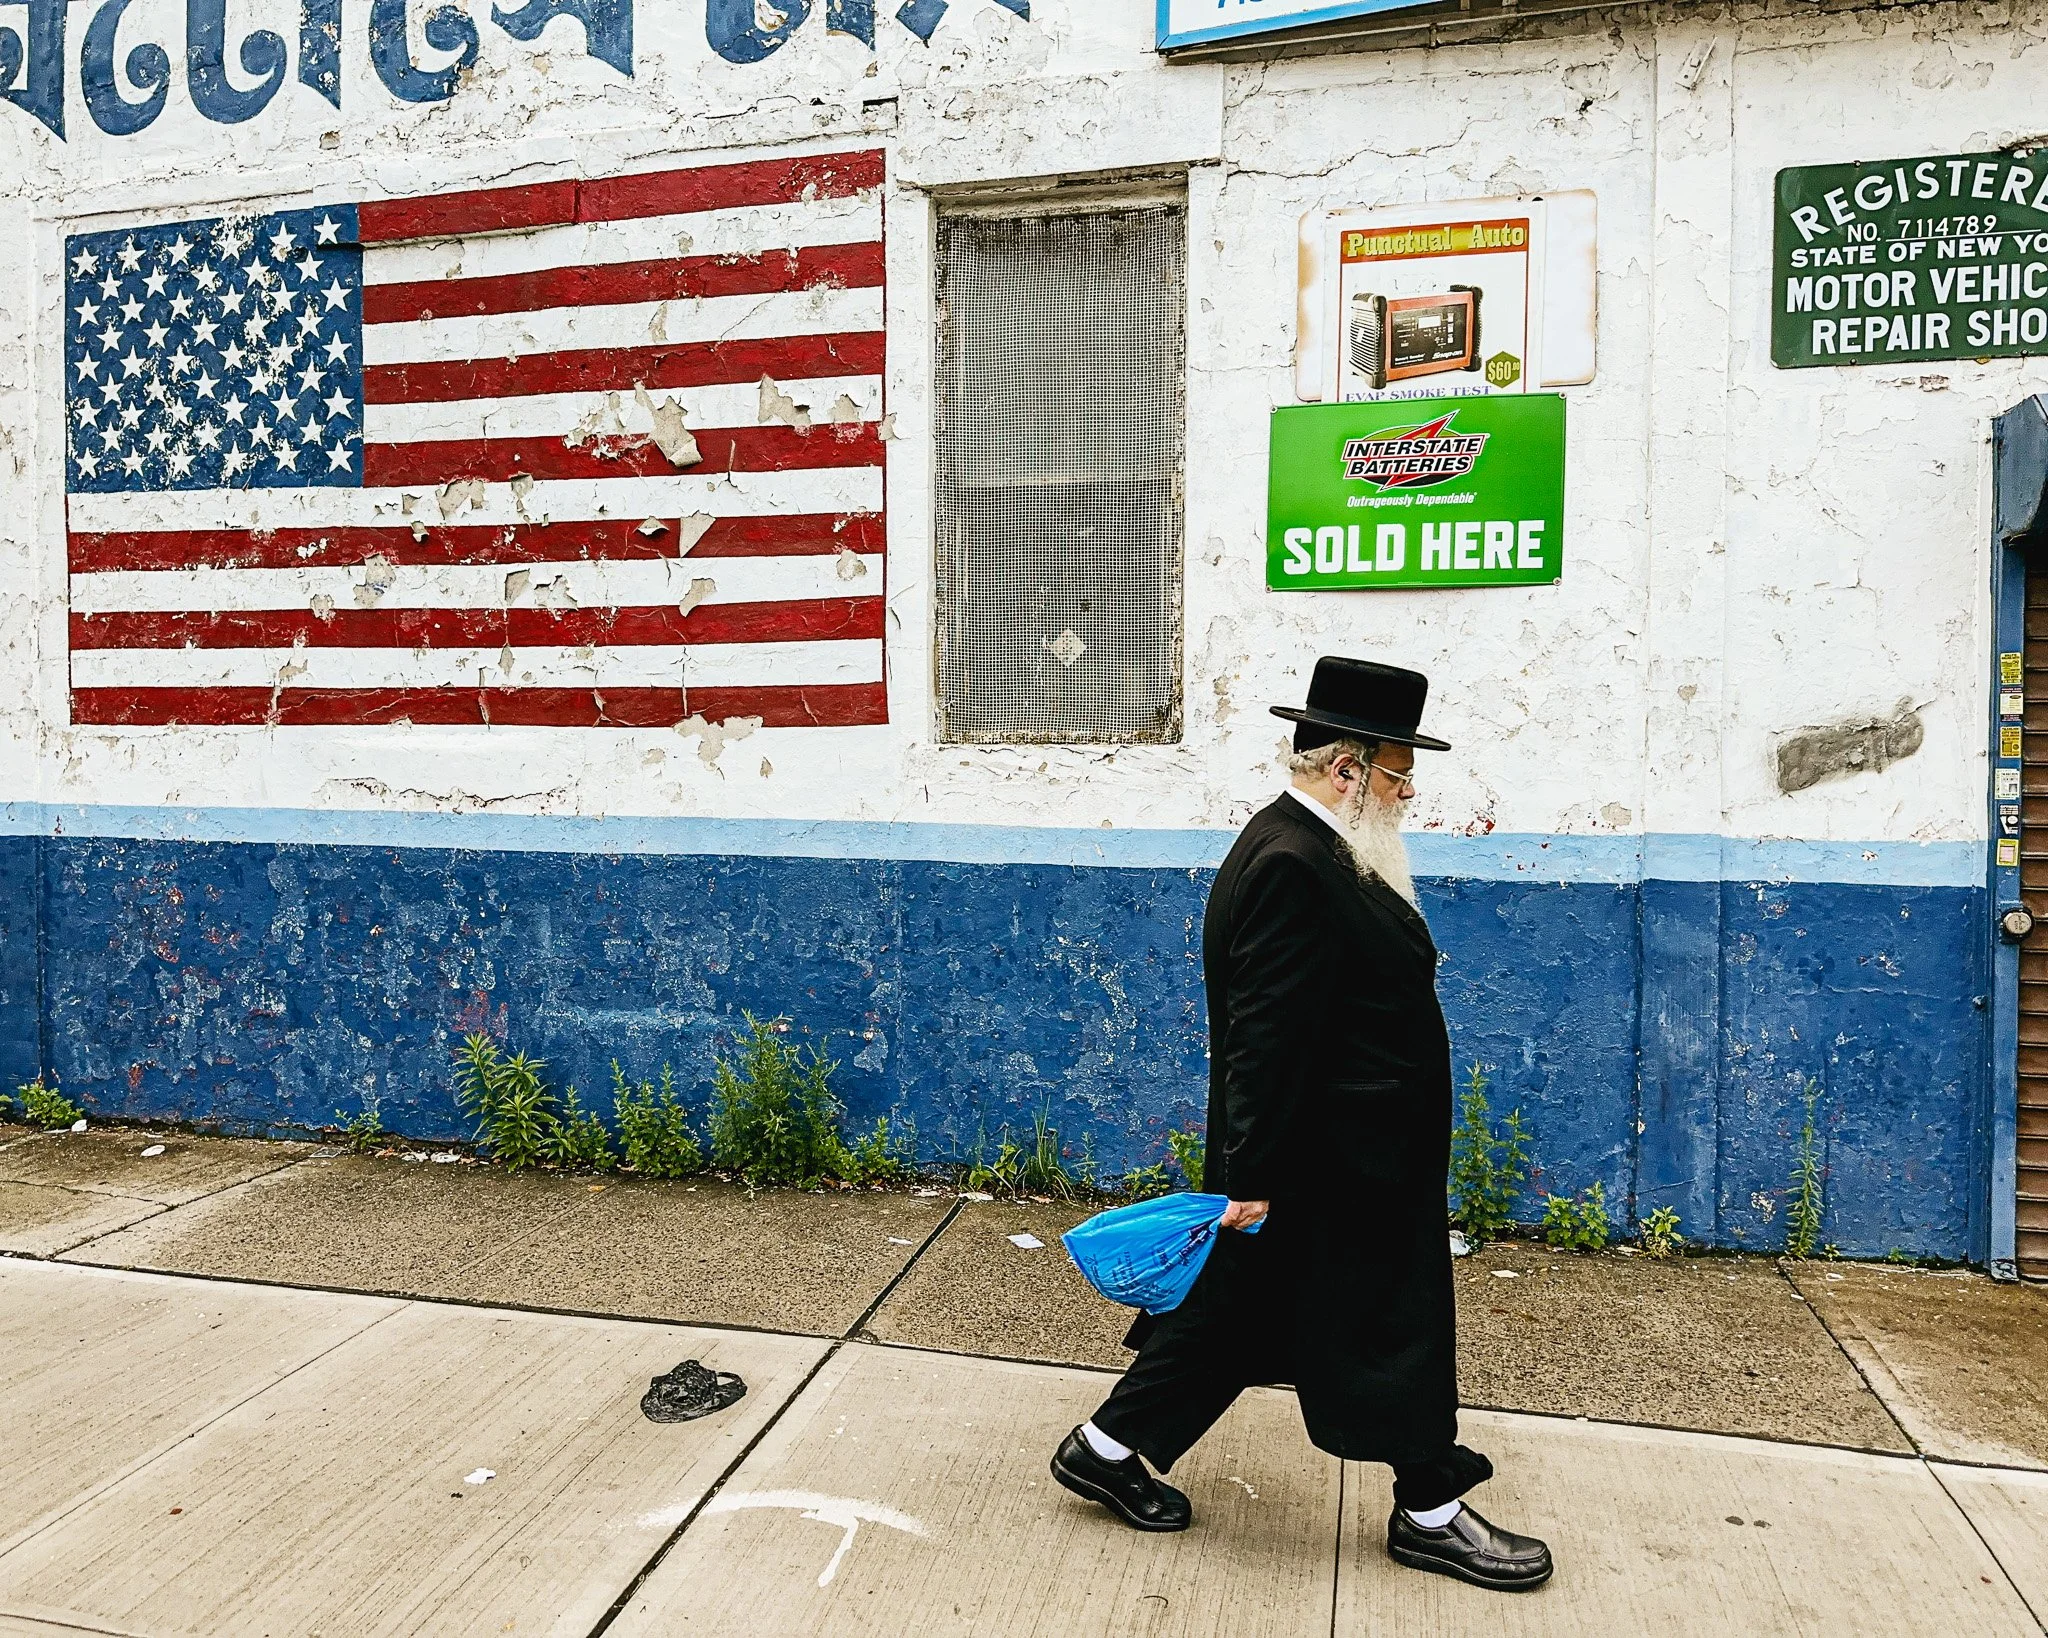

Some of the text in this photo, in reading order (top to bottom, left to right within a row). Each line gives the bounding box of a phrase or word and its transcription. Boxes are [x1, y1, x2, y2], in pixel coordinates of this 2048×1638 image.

[1347, 223, 1525, 257] Punctual Auto
[1847, 214, 1997, 243] NO. 7114789
[1791, 245, 1877, 268] STATE
[1888, 241, 1926, 262] OF
[1937, 236, 2002, 259] NEW
[1787, 262, 2048, 313] MOTOR VEHIC
[1813, 307, 2048, 355] REPAIR SHO
[1346, 385, 1492, 402] EVAP SMOKE TEST
[1347, 437, 1481, 457] INTERSTATE
[1350, 456, 1470, 475] BATTERIES
[1347, 492, 1475, 508] Outrageously Dependable
[1283, 520, 1545, 575] SOLD HERE
